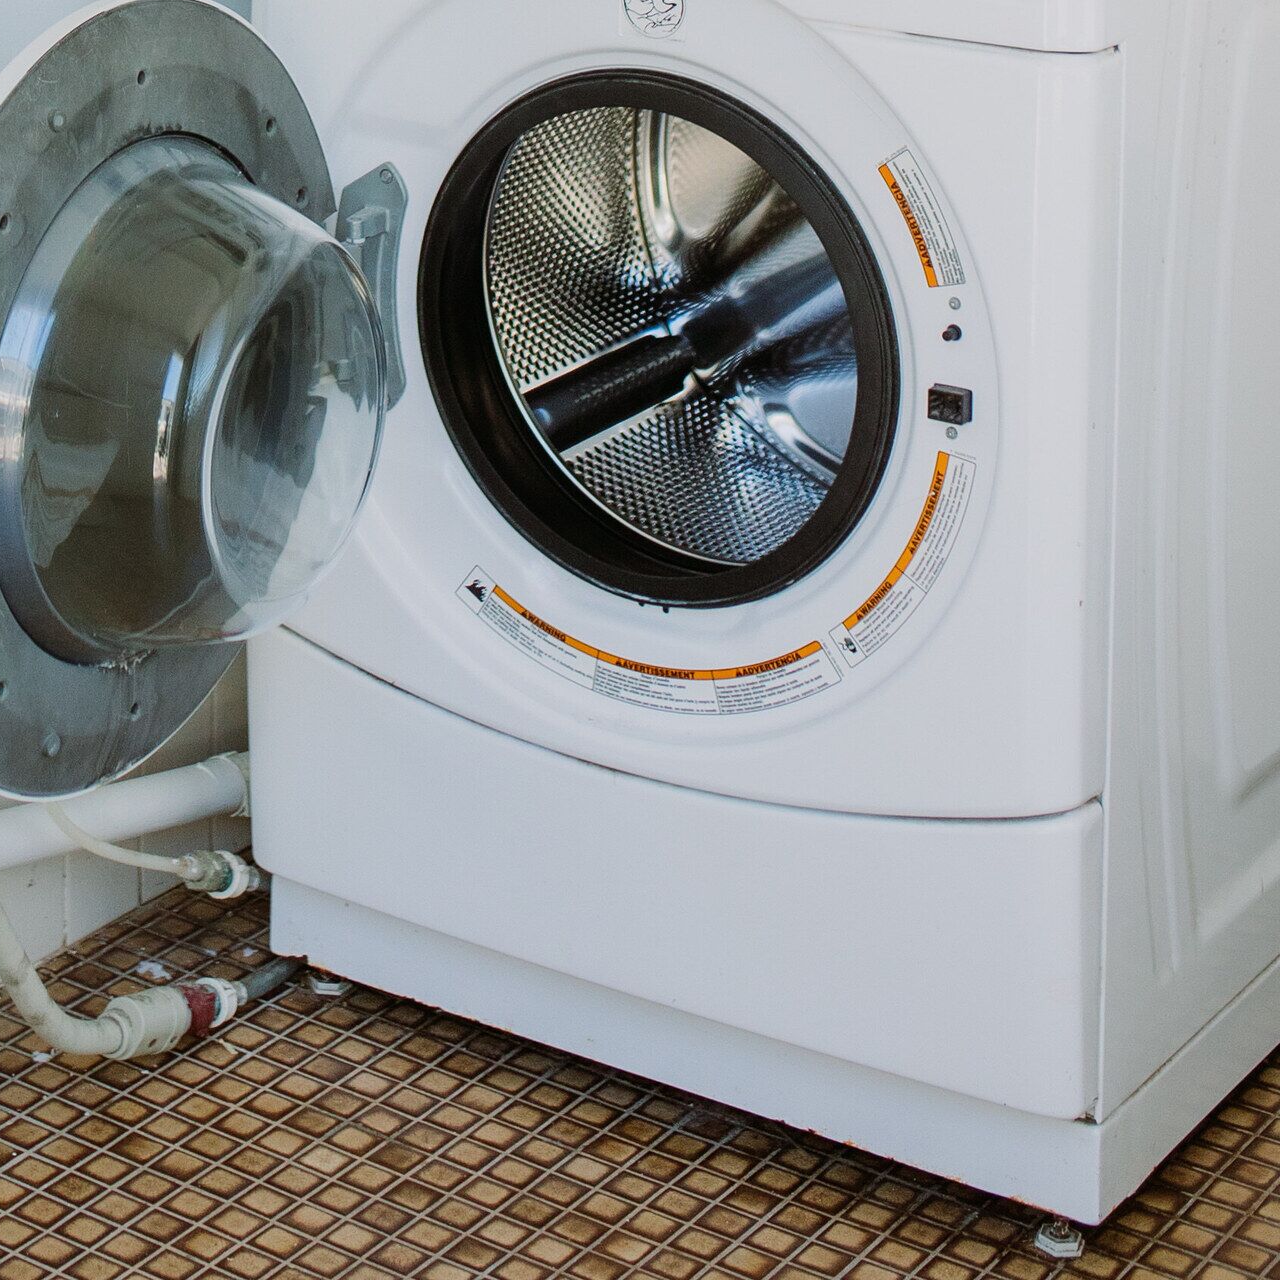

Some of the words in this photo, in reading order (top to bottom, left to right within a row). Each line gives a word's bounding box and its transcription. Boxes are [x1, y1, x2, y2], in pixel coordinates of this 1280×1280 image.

[890, 180, 930, 261] ADVERTENCIA
[910, 470, 945, 548] AVERTISSEMENT
[860, 580, 893, 615] WARNING
[526, 613, 567, 643] WARNING
[621, 661, 695, 680] AVERTISSEMENT
[741, 651, 803, 677] ADVERTENCIA
